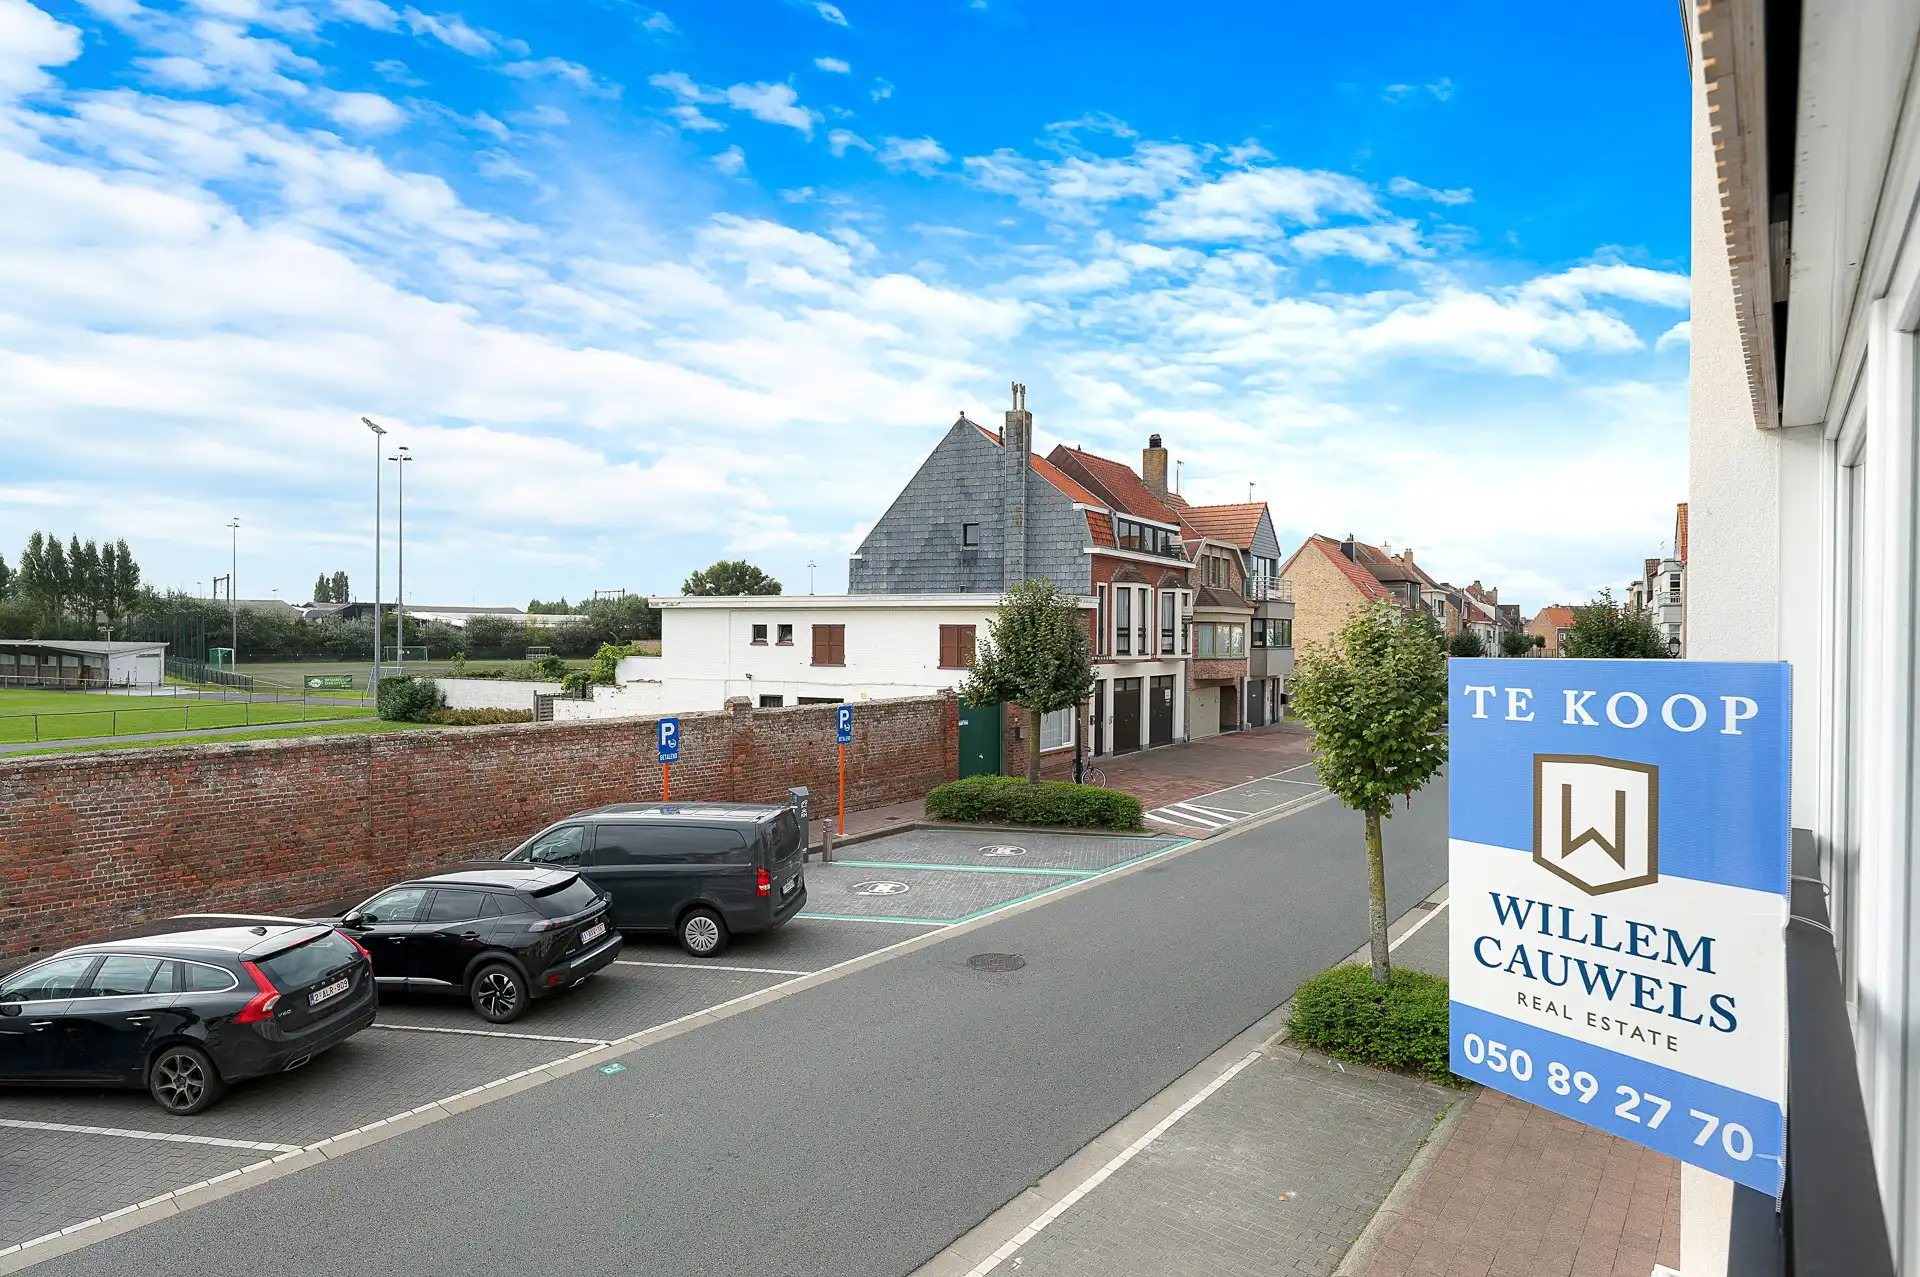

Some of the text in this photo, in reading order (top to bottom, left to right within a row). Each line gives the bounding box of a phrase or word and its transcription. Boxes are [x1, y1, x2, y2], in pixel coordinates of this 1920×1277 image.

[661, 722, 675, 746] P
[839, 709, 850, 729] P
[1464, 684, 1760, 736] TE KOOP
[659, 752, 678, 761] BETALEND
[1488, 891, 1717, 976] WILLEM
[1473, 935, 1739, 1034] CAUWELS
[1517, 991, 1679, 1053] REAL ESTATE
[1463, 1032, 1755, 1163] 050 89 27 70
